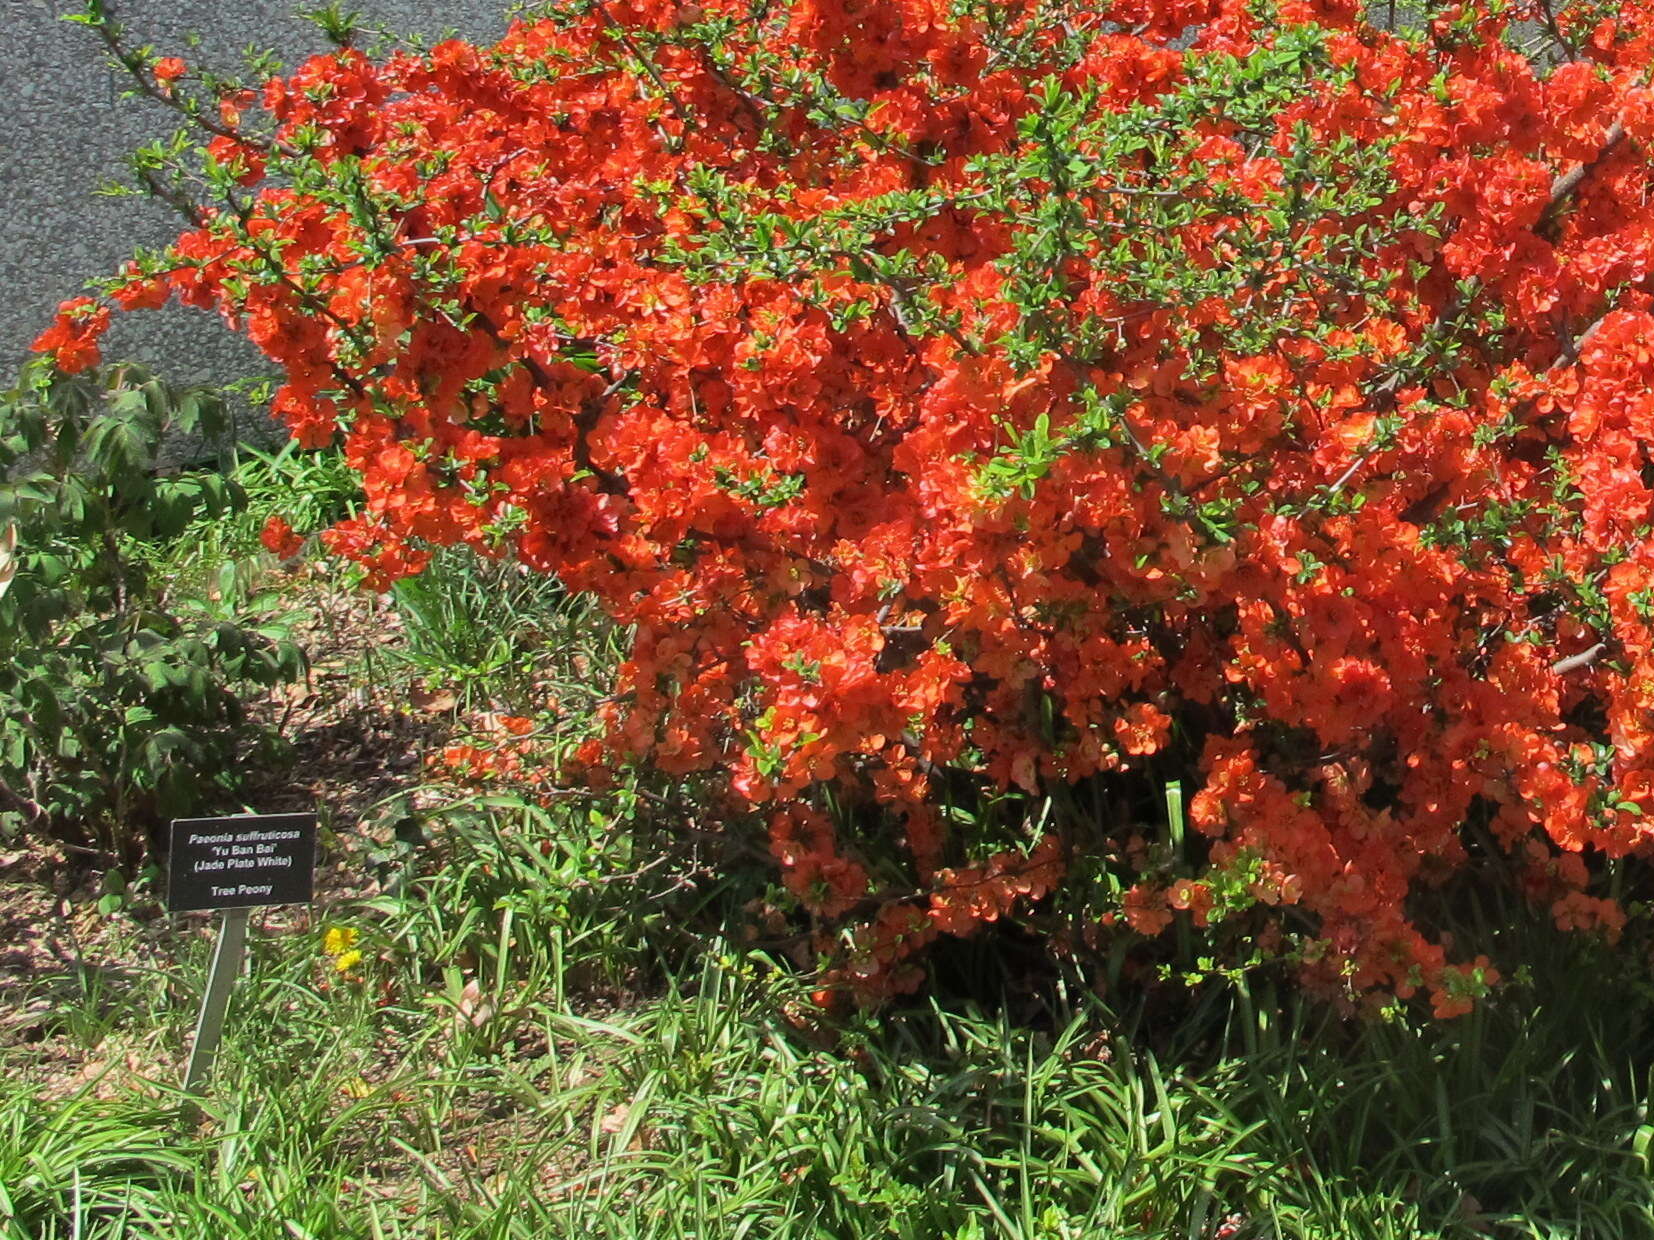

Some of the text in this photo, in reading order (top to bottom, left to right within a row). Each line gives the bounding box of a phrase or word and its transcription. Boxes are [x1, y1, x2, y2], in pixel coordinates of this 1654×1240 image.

[188, 833, 233, 844] Paeonia
[231, 845, 254, 855] Ban
[194, 855, 293, 873] (Jade Plate White)
[211, 884, 273, 897] Tree Peony
